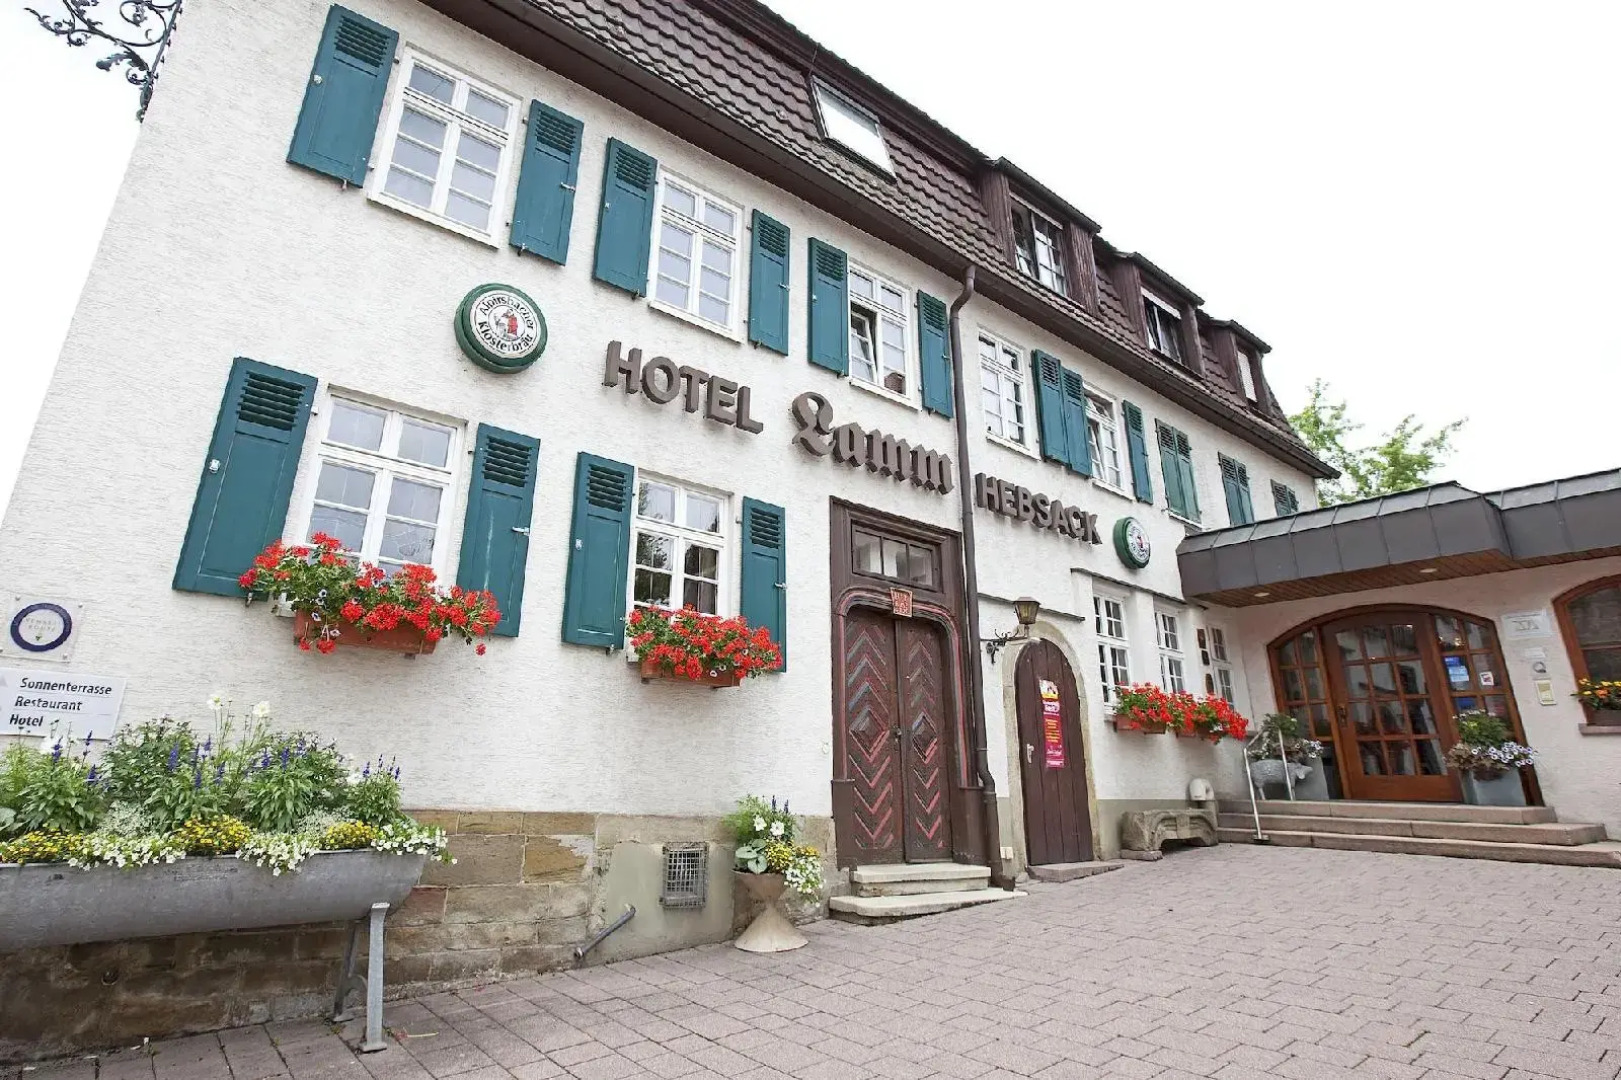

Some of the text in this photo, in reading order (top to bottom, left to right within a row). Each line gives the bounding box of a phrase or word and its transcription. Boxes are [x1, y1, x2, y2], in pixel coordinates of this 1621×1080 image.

[603, 340, 1103, 545] HOTEL Lamm HEBSACK
[20, 677, 112, 695] Sonnenterrasse
[15, 696, 83, 711] Restaurant
[9, 713, 44, 727] Hotel
